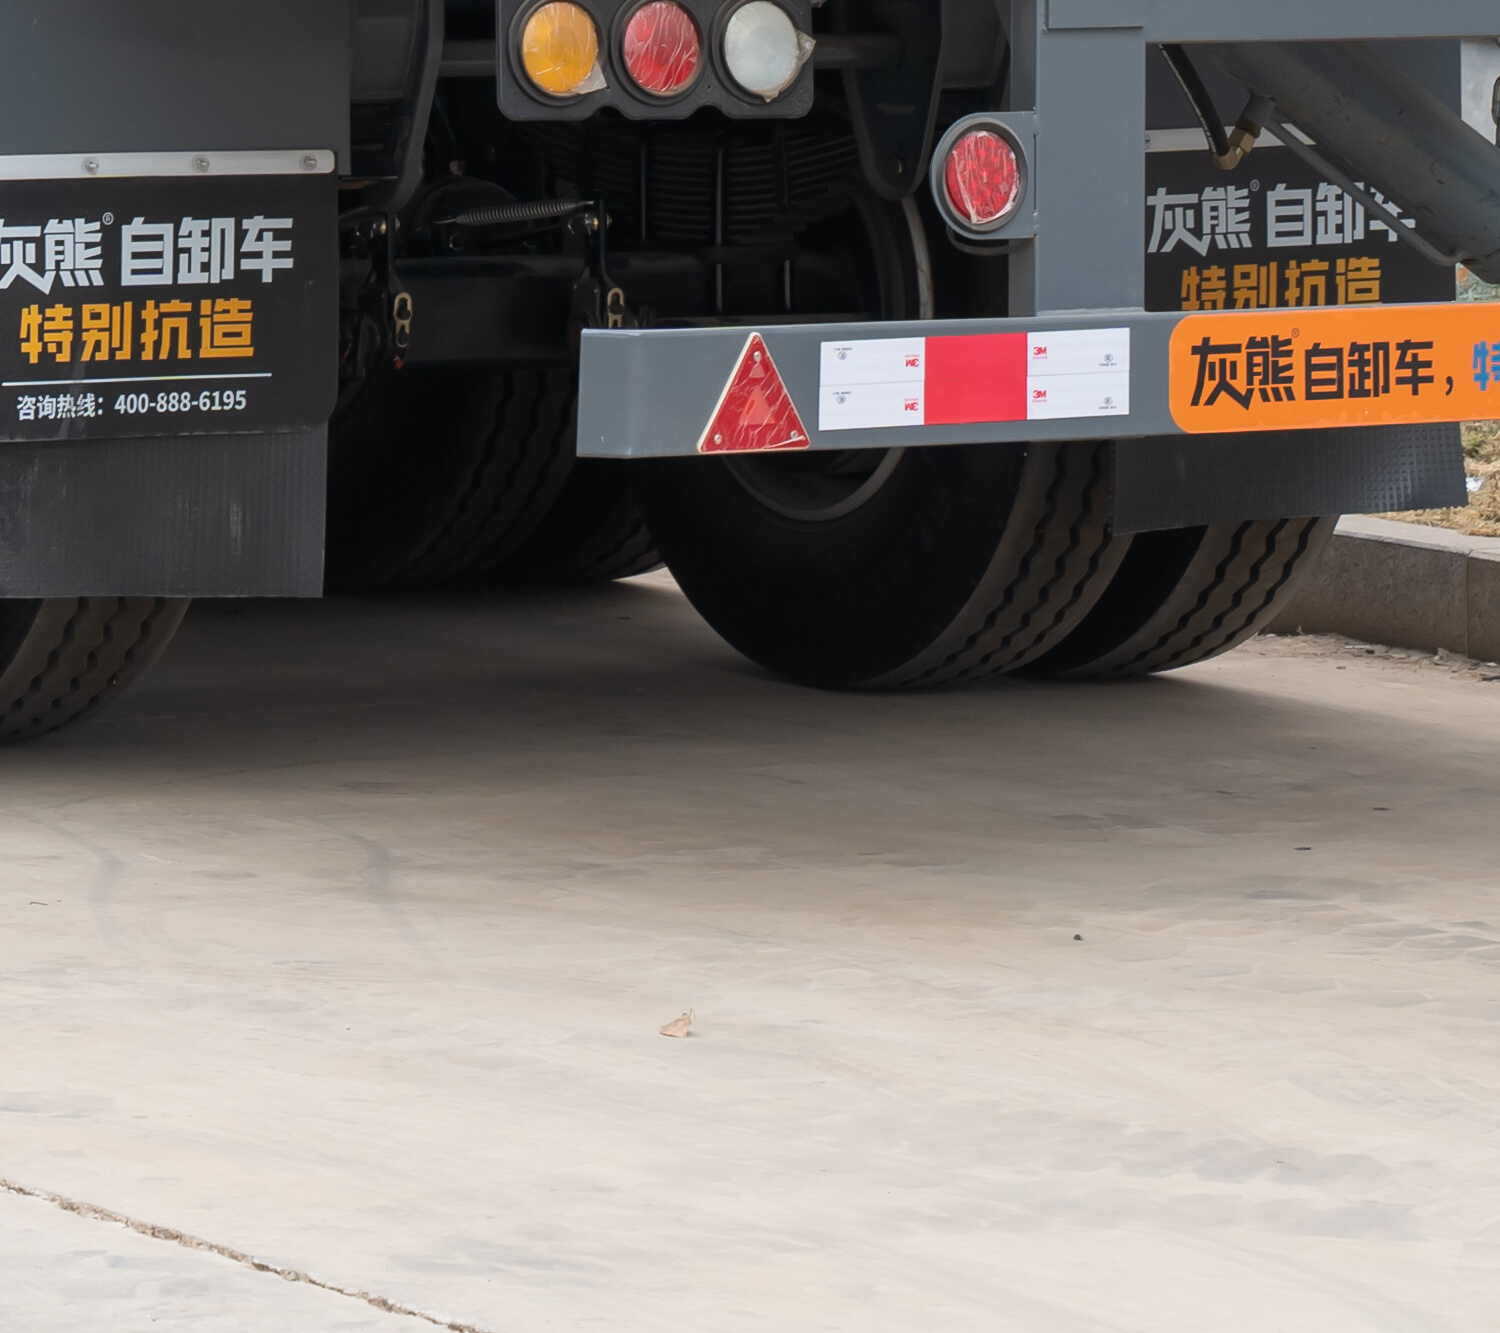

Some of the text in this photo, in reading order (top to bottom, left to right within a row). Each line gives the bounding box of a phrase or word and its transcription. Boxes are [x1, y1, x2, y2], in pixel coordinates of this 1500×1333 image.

[19, 297, 254, 364] 特别抗造
[1034, 346, 1047, 356] 3M
[1033, 390, 1047, 399] 3M
